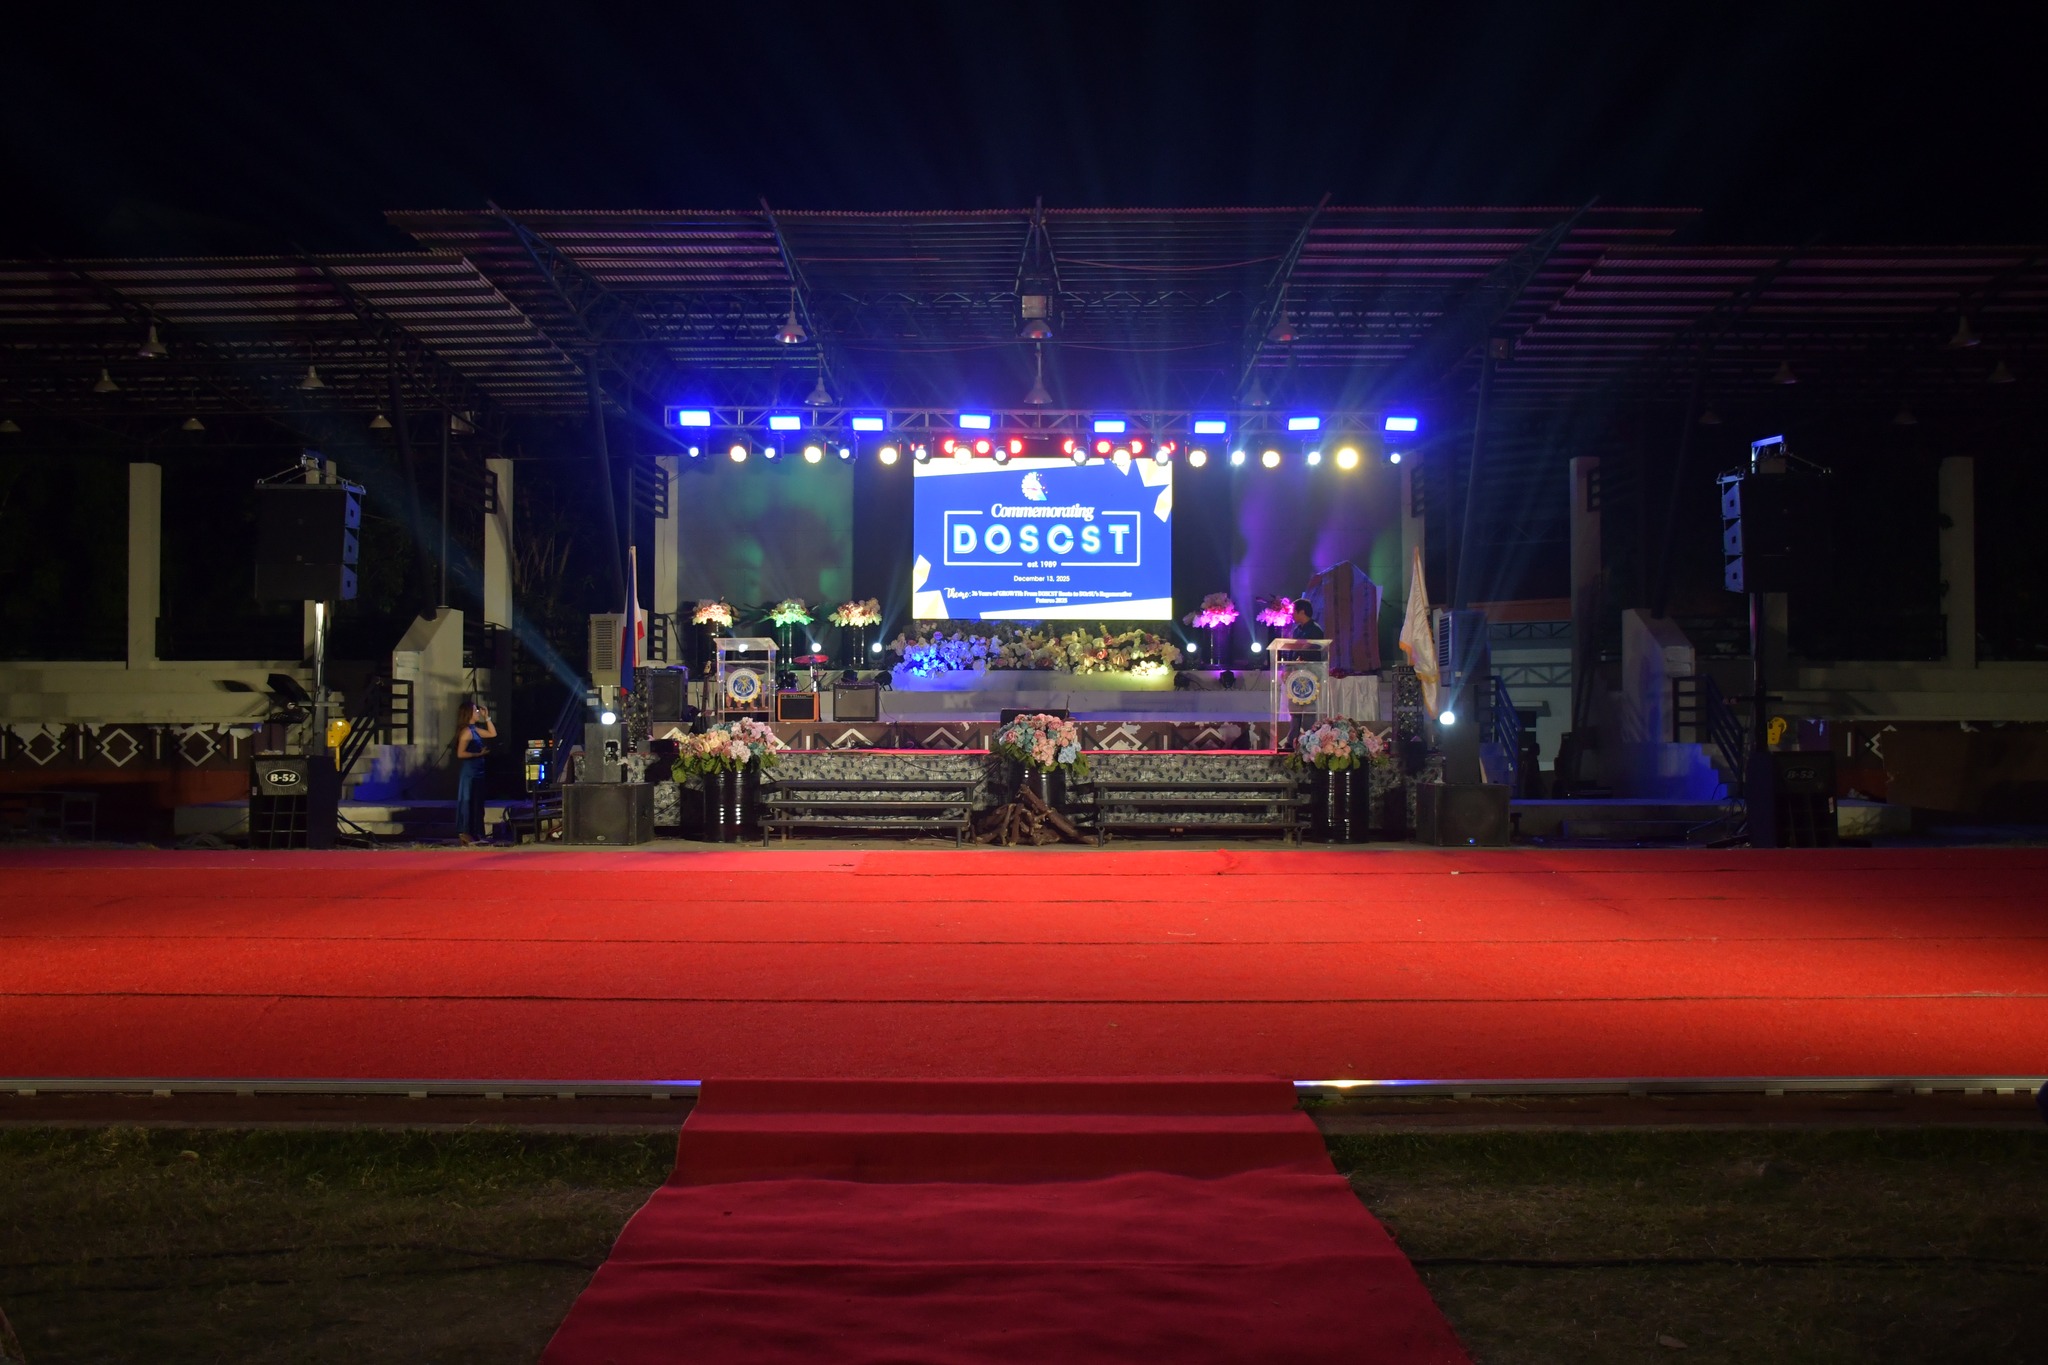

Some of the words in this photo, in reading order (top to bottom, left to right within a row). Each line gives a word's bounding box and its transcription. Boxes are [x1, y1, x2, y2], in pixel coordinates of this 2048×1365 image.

[991, 503, 1095, 522] Commemorating
[953, 524, 1131, 555] DOSCST
[1040, 560, 1057, 568] 1989
[270, 773, 296, 782] B-52
[1787, 770, 1815, 779] B-52
